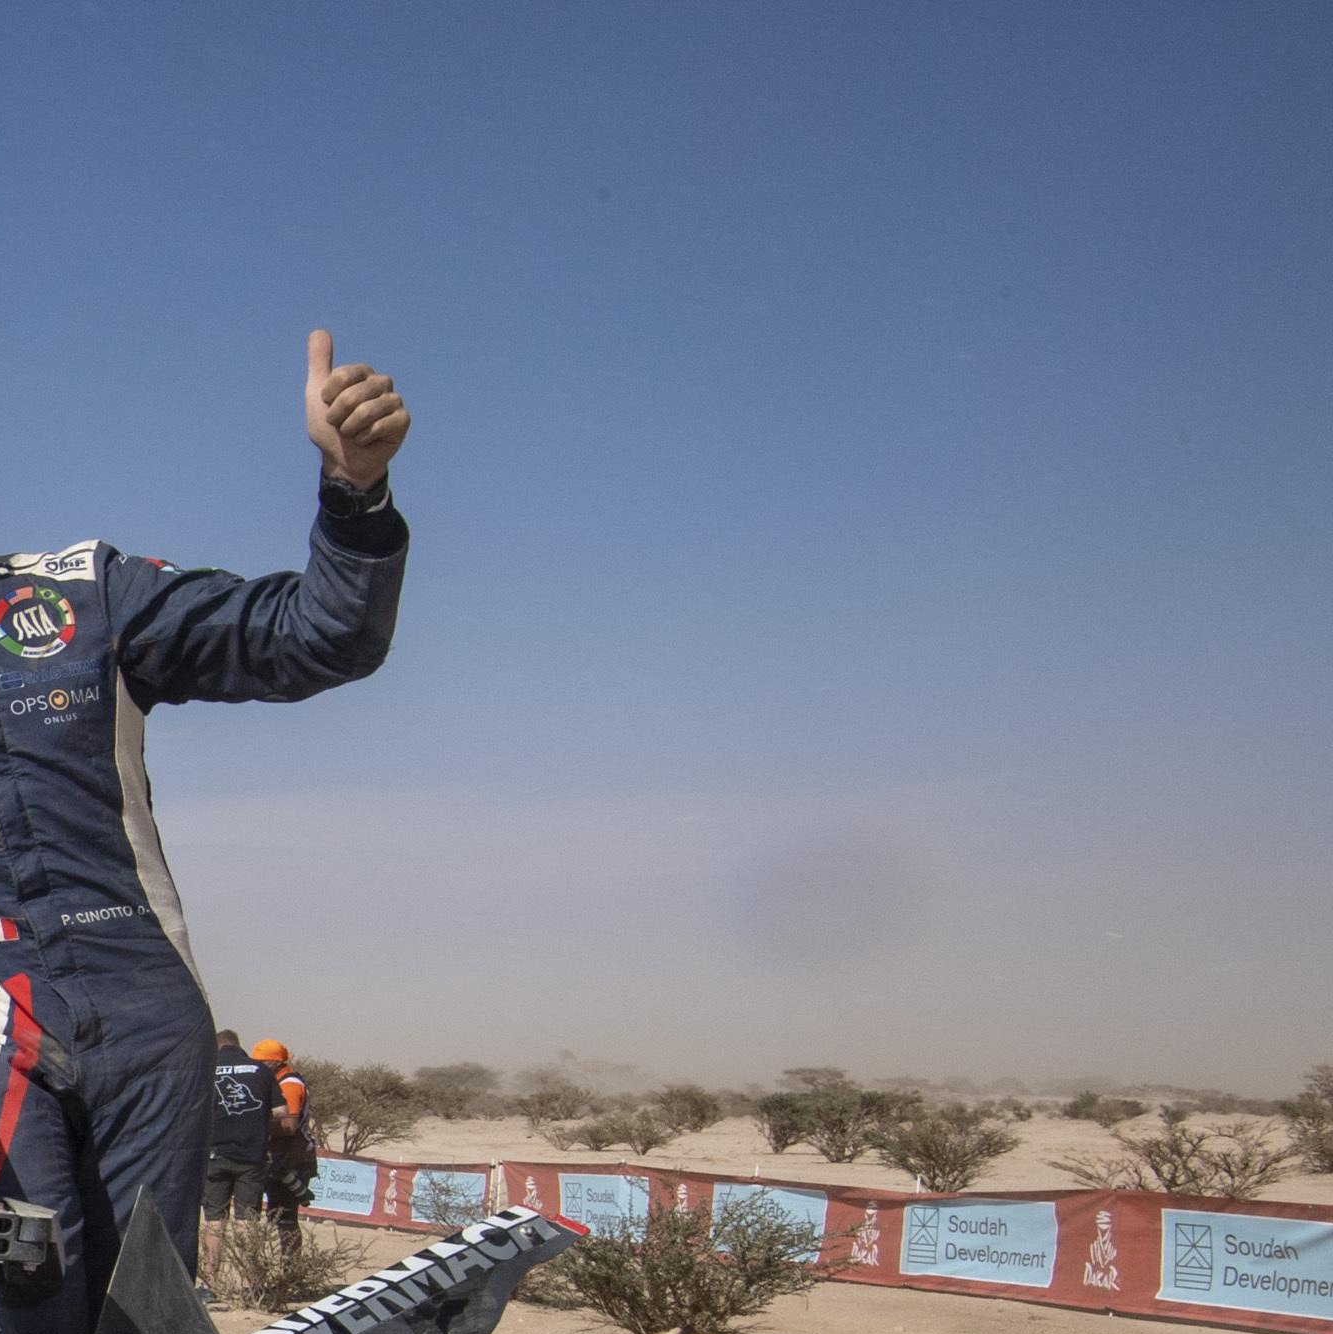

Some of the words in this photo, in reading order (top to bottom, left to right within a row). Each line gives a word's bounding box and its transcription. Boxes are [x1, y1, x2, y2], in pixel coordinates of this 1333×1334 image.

[11, 604, 60, 642] SATA
[44, 713, 78, 725] ONLUS
[76, 906, 133, 924] CINOTTO
[329, 1169, 357, 1185] Soudah
[326, 1187, 372, 1204] Development
[947, 1214, 1008, 1237] Soudah
[945, 1242, 1047, 1269] Development
[1224, 1234, 1299, 1261] Soudah
[1083, 1261, 1121, 1291] DAKAR
